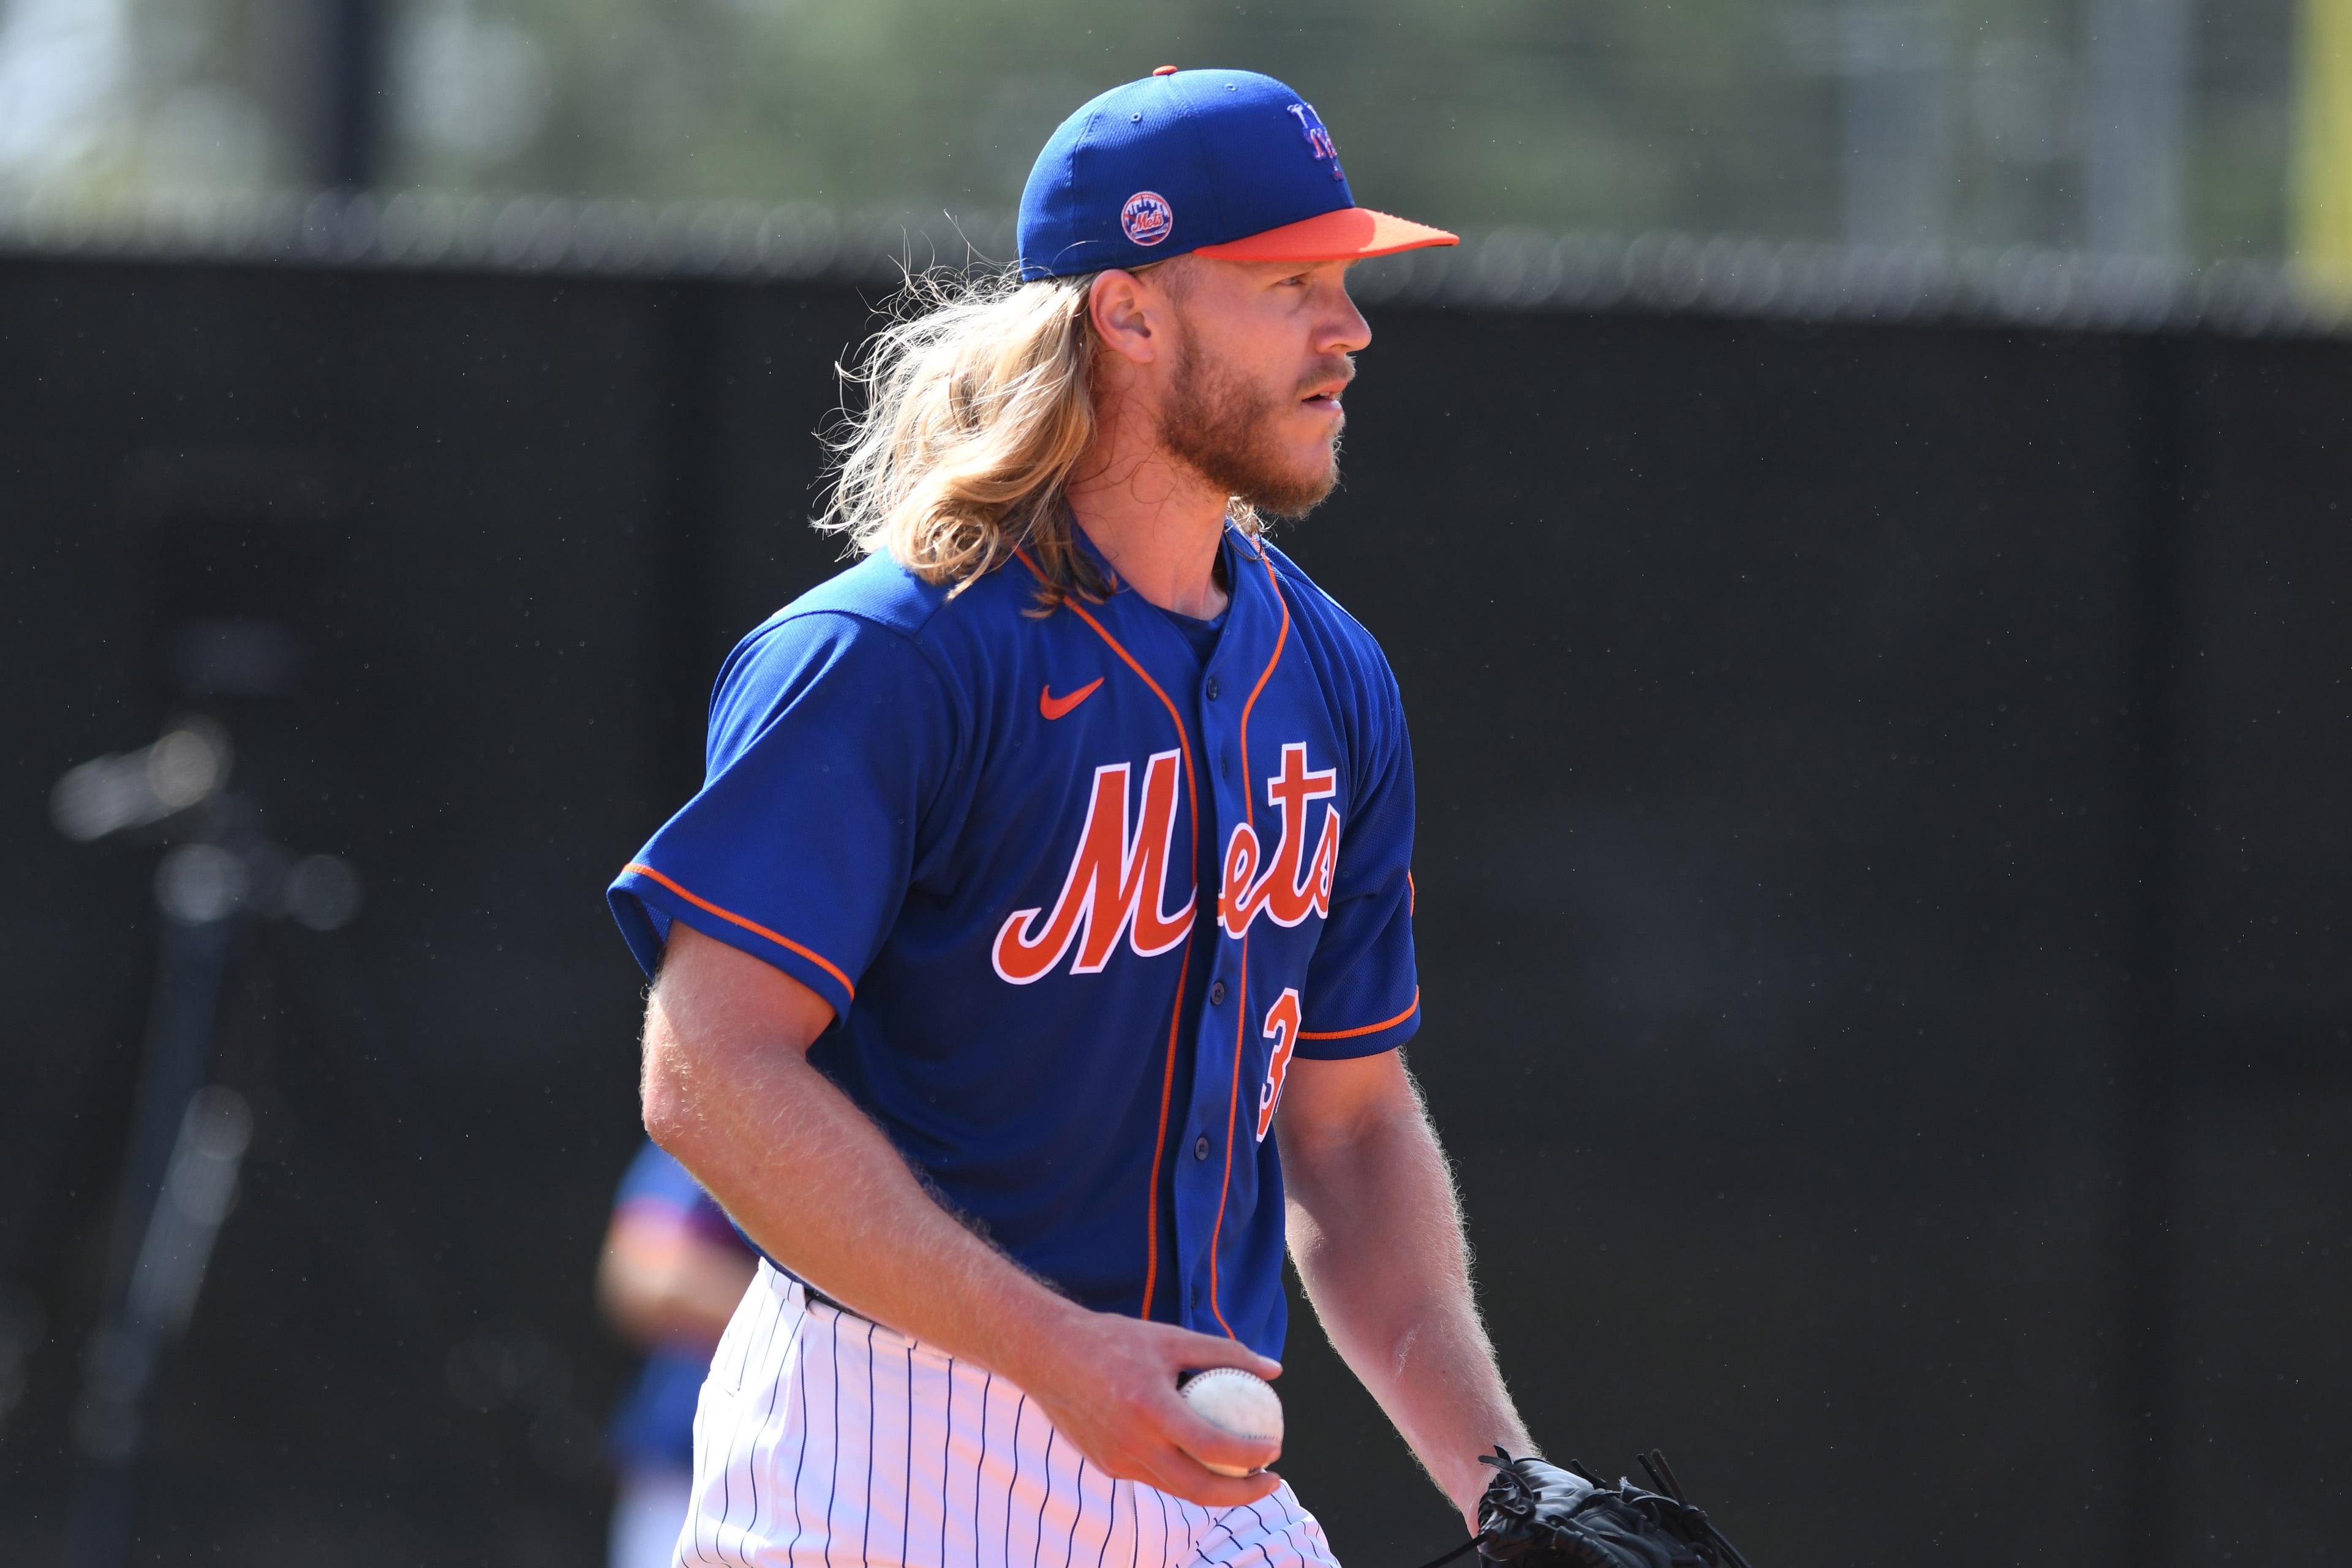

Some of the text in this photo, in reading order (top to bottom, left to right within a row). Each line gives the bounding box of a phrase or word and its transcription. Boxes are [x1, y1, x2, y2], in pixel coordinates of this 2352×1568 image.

[1131, 210, 1164, 232] Mets
[992, 741, 1340, 985] Mets
[1256, 987, 1302, 1143] 3
